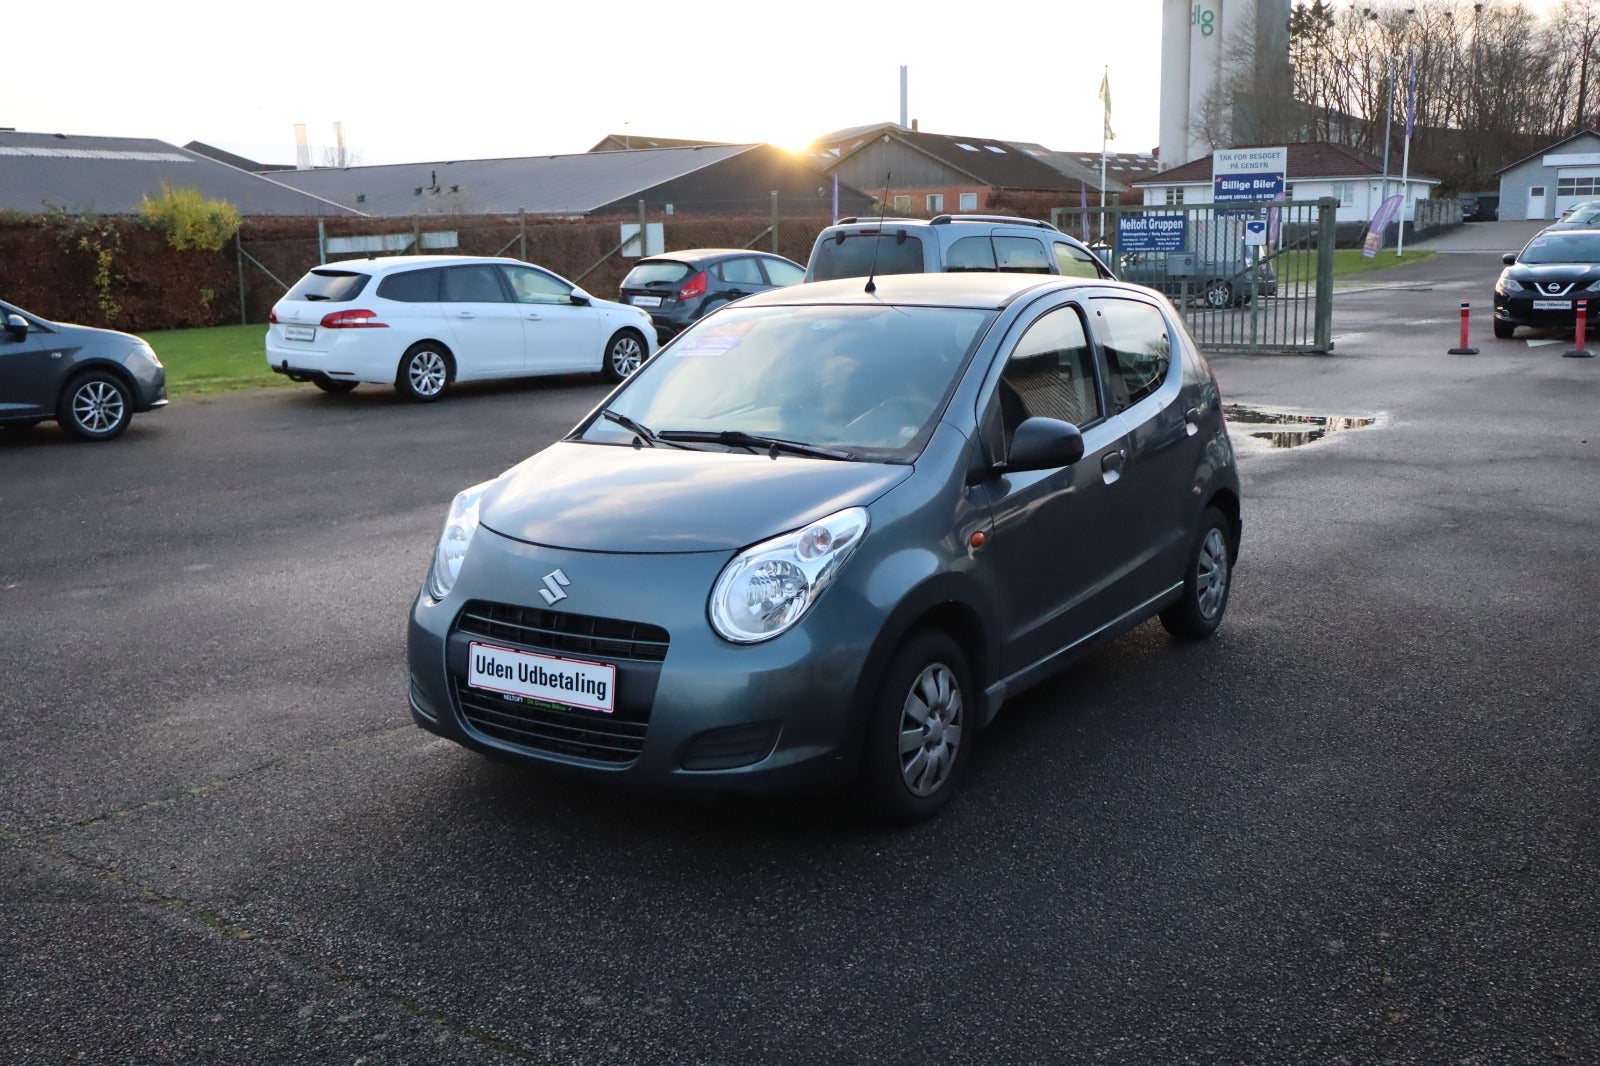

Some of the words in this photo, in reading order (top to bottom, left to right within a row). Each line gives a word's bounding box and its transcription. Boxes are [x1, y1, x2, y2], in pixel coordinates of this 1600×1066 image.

[1249, 152, 1280, 160] BESØGET
[1240, 161, 1269, 169] GENSYN
[1221, 180, 1250, 191] Billige
[1253, 179, 1276, 189] Biler
[1120, 218, 1147, 230] Neltoft
[1148, 217, 1183, 231] Gruppen
[476, 654, 513, 680] Uden
[518, 662, 607, 701] Udbetaling
